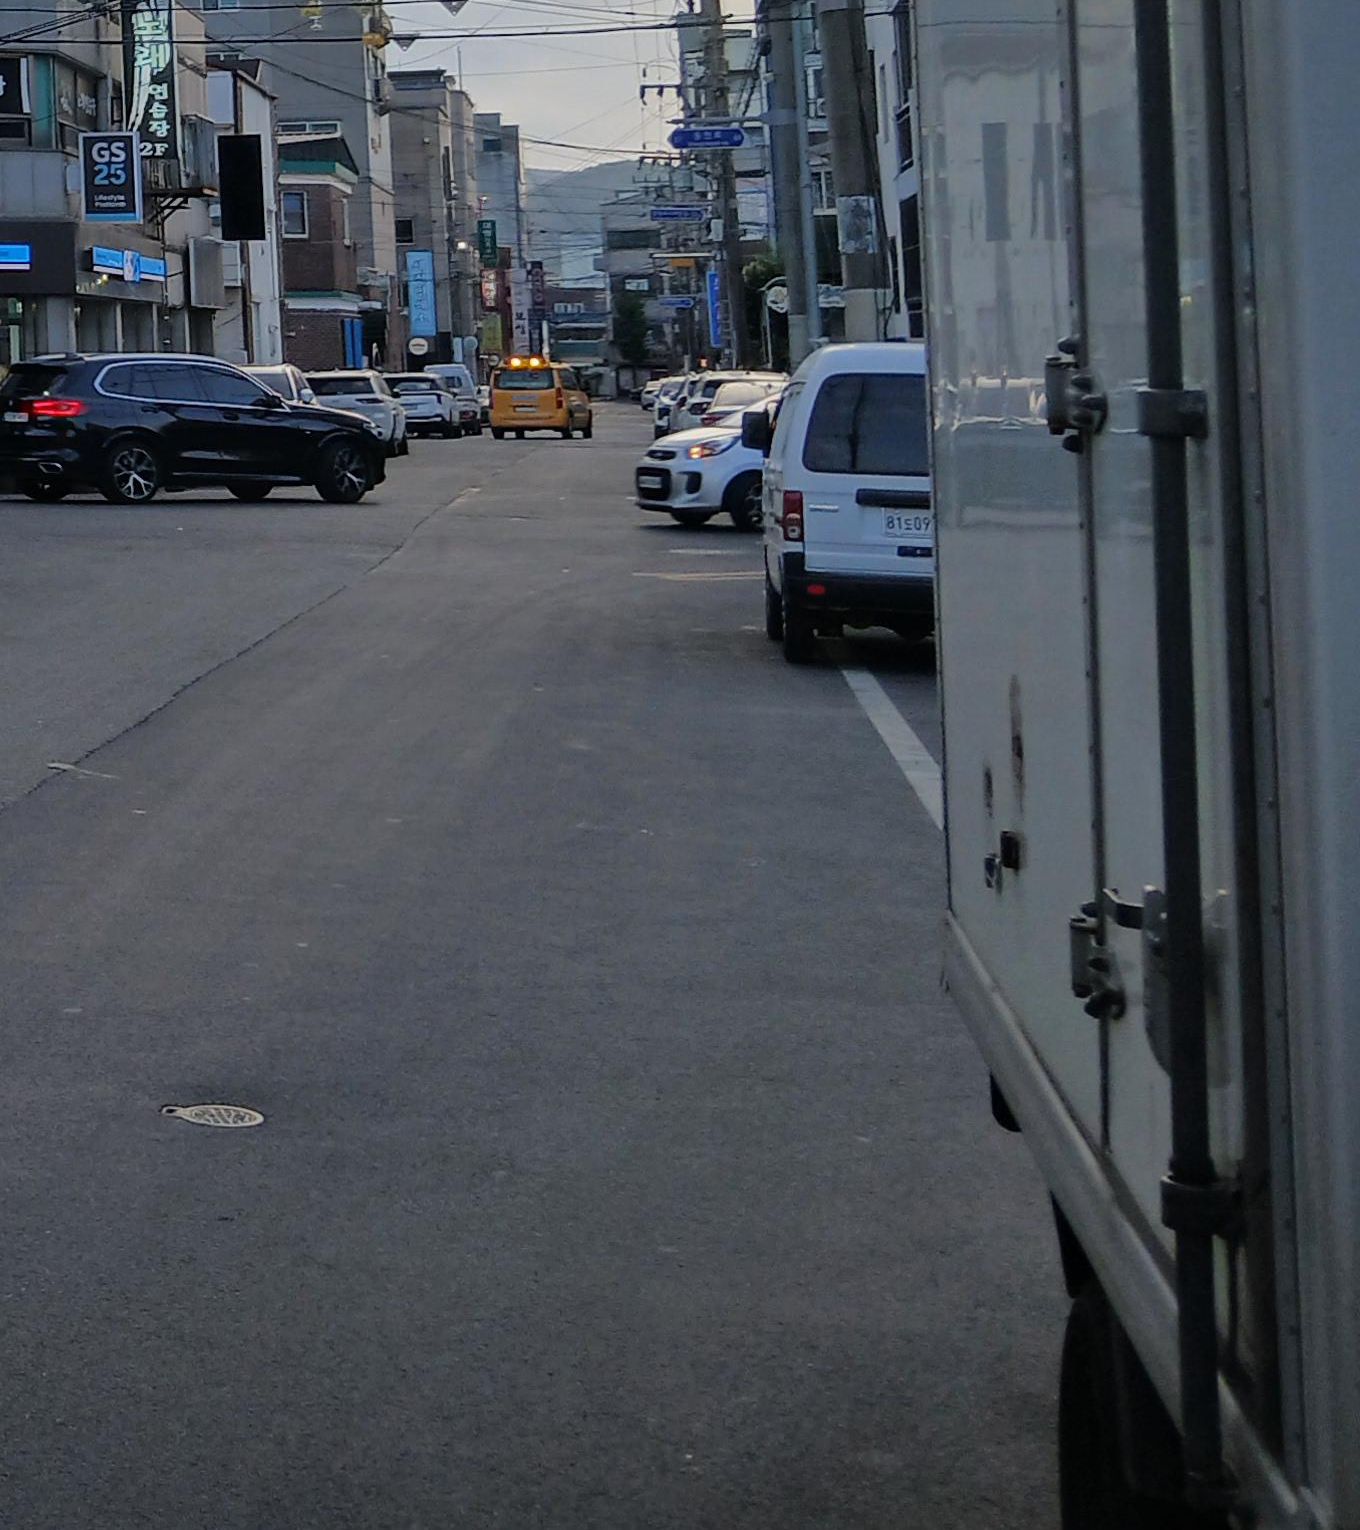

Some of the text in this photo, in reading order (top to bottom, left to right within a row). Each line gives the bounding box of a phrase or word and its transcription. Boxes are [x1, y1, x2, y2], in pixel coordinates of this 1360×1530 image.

[147, 82, 171, 138] 연습장
[91, 142, 126, 163] GS
[140, 142, 169, 157] 2F
[94, 163, 126, 185] 25
